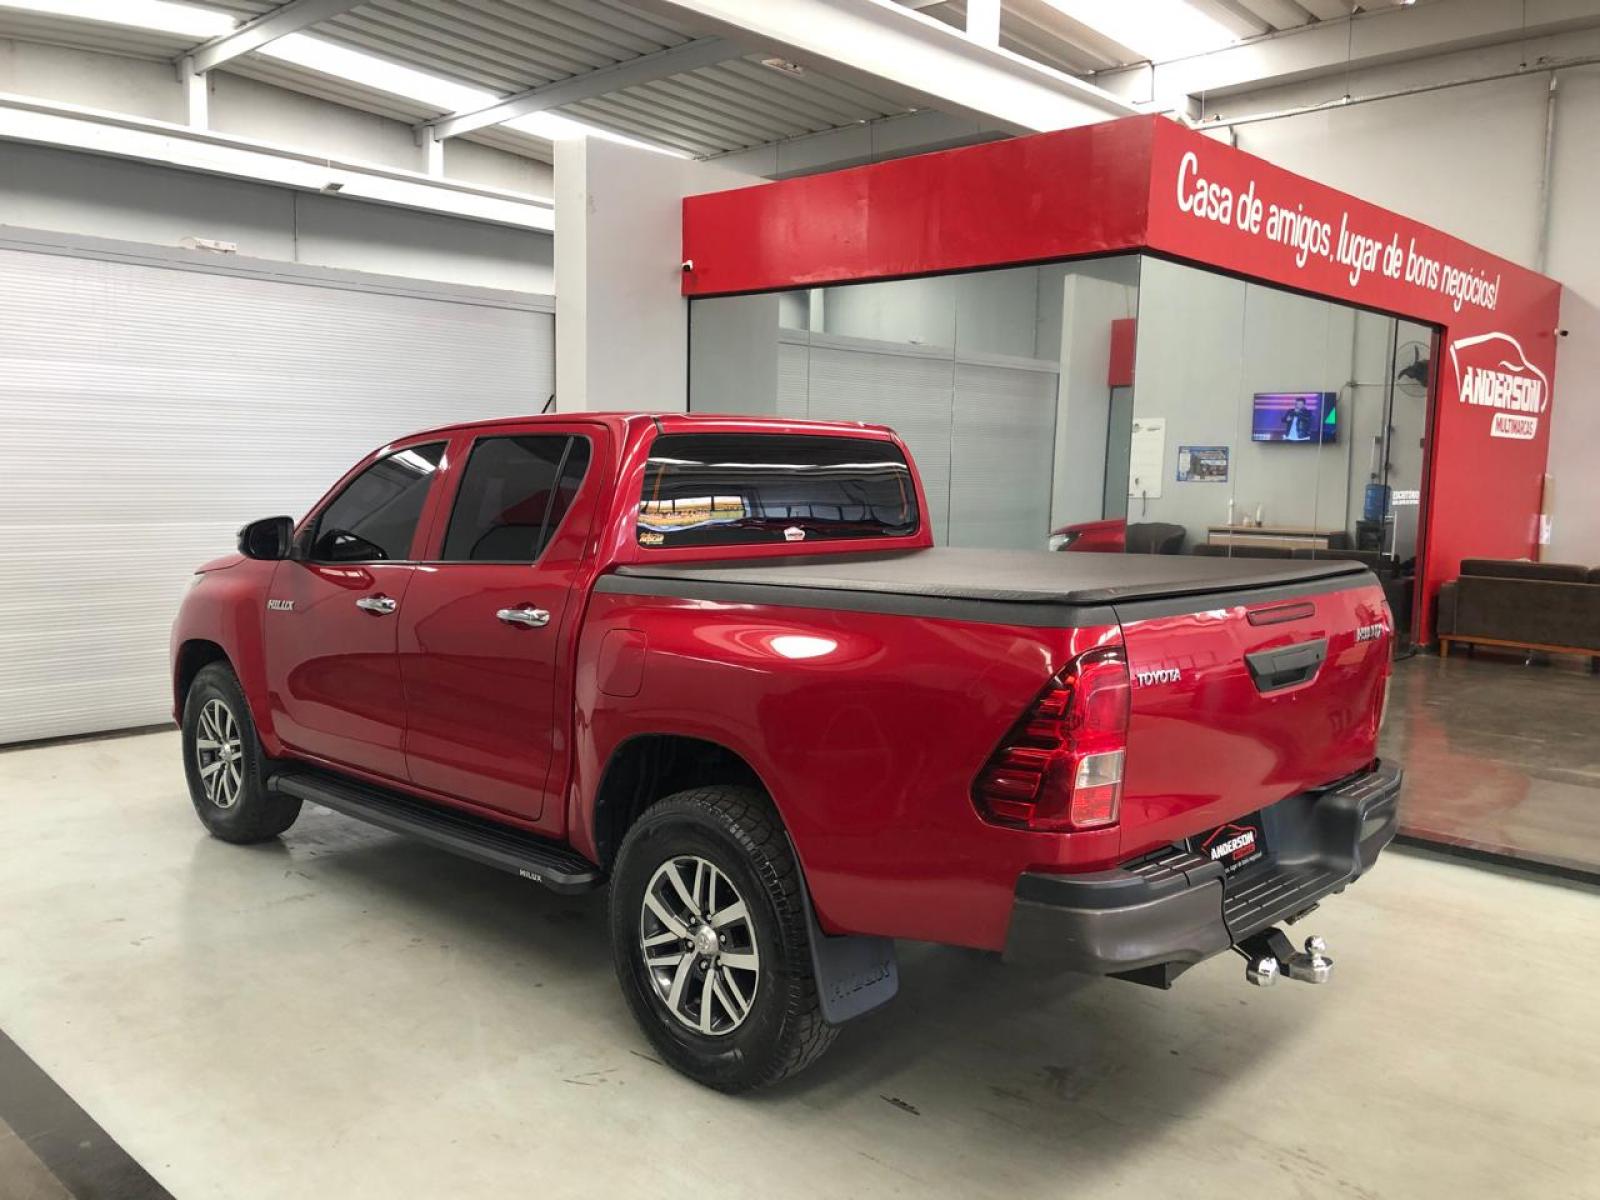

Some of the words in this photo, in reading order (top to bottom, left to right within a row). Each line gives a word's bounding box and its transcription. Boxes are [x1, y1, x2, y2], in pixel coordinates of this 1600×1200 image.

[1176, 151, 1232, 225] Casa
[1236, 181, 1263, 234] de
[1266, 203, 1334, 269] amigos,
[1336, 212, 1382, 287] lugar
[1382, 232, 1404, 277] de
[1405, 238, 1439, 292] bons
[1440, 267, 1501, 312] negócios!
[1459, 365, 1542, 413] ANDERSON
[1137, 668, 1181, 687] TOYOTA
[1211, 831, 1255, 860] ANDERSON
